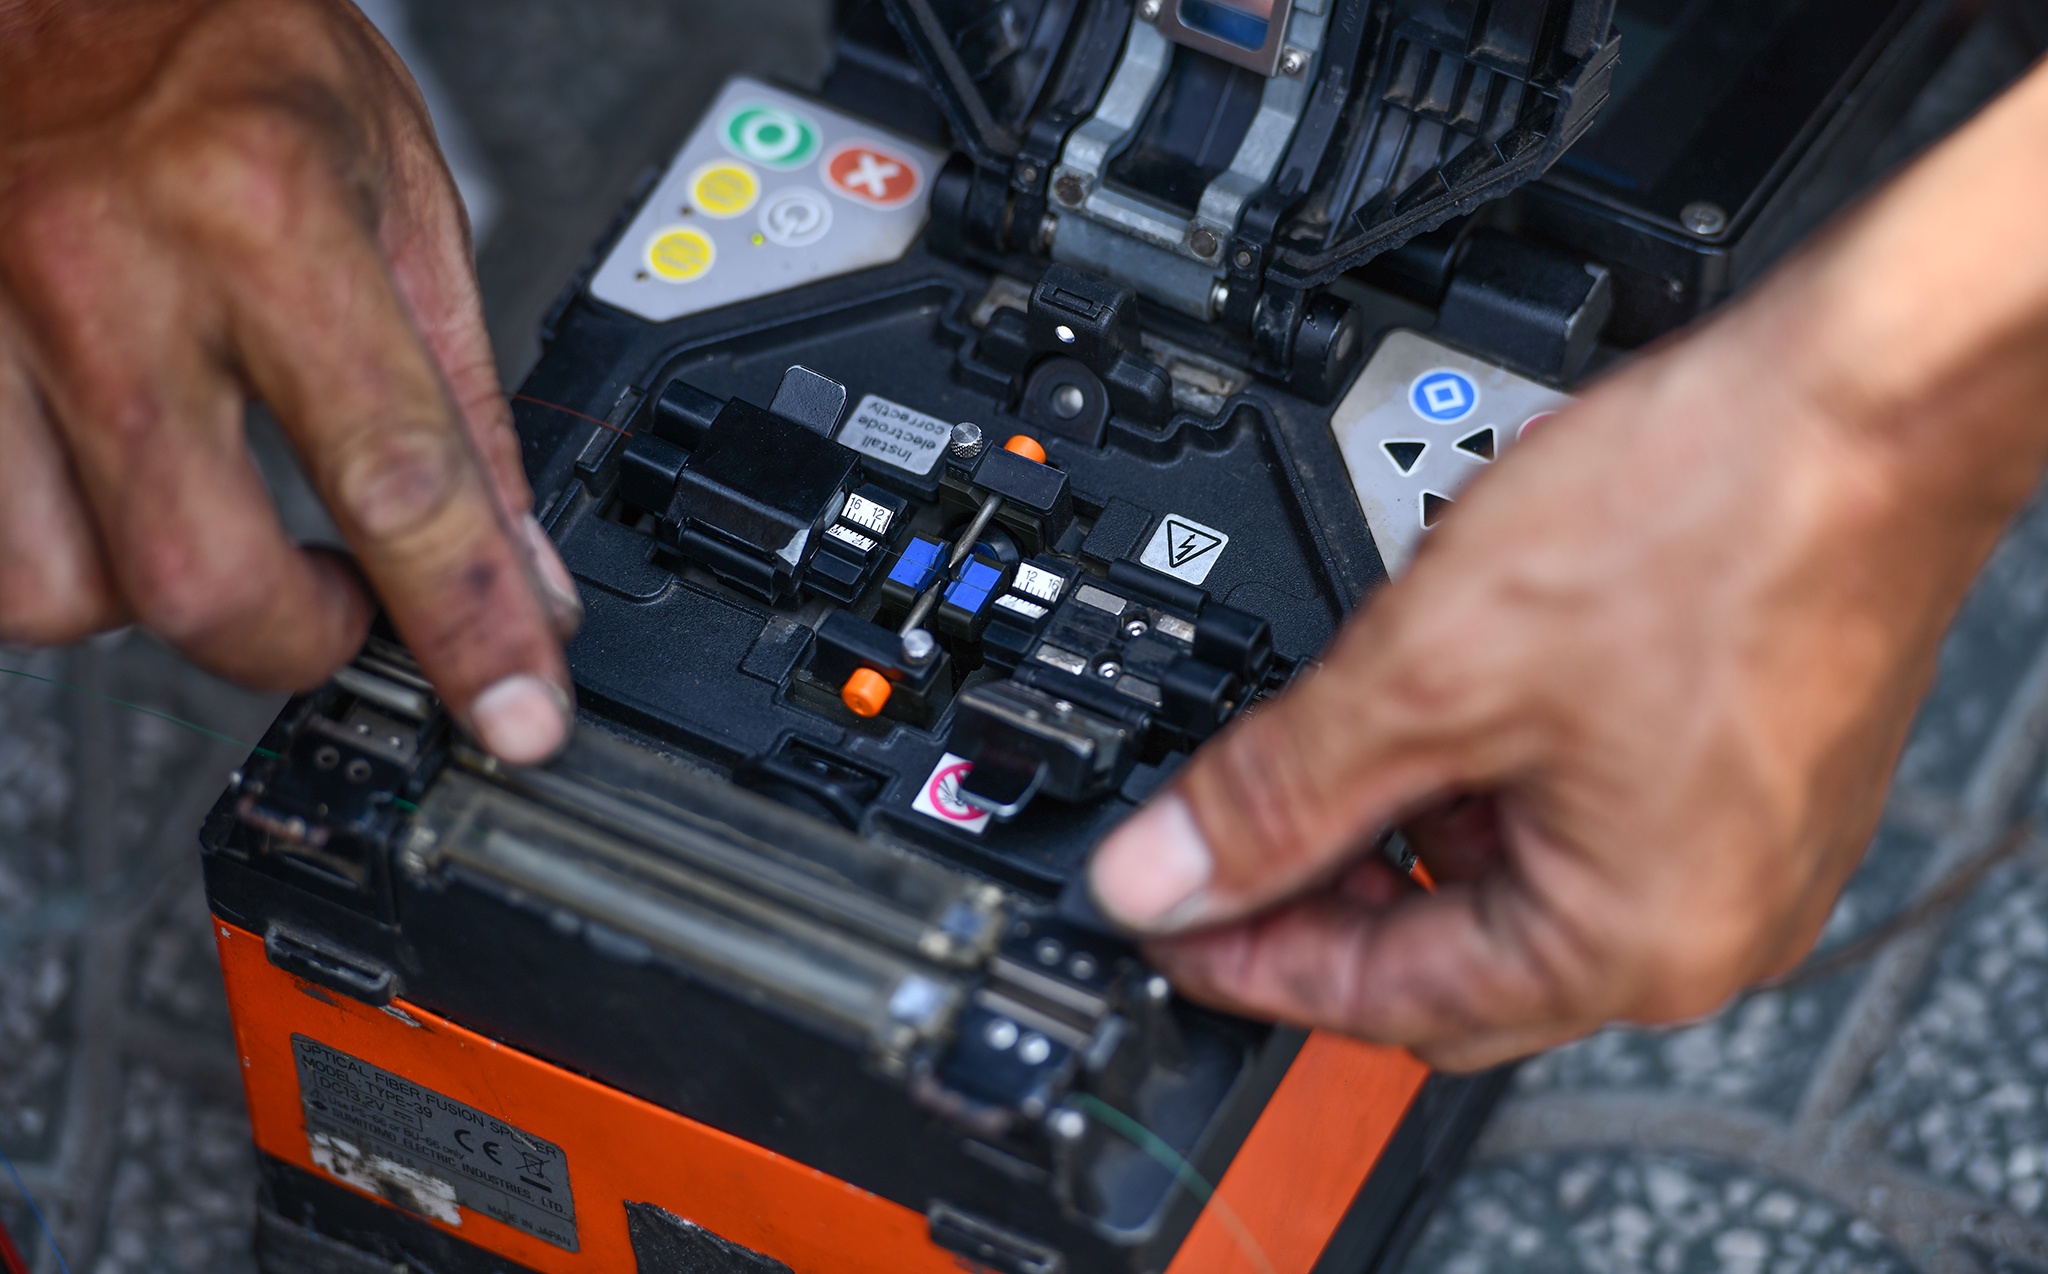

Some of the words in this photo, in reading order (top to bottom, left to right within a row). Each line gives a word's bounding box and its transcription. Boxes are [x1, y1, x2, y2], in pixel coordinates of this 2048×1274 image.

[858, 414, 937, 450] electrode
[867, 402, 945, 435] correctly
[861, 435, 912, 463] Install
[850, 496, 863, 510] 16
[872, 506, 885, 521] 12
[1026, 569, 1038, 583] 12
[1048, 578, 1061, 591] 16
[300, 1043, 370, 1079] OPTICAL
[374, 1072, 421, 1101] FIBER
[426, 1093, 485, 1128] FUSION
[319, 1076, 385, 1112] DC13.2V
[364, 1081, 433, 1119] TYPE-39
[331, 1107, 397, 1142] SUMITOMO
[403, 1137, 456, 1168] ELECTRIC
[541, 1196, 568, 1216] LTD.
[403, 1127, 441, 1151] BU-66
[442, 1145, 464, 1160] only
[454, 1129, 503, 1167] CE
[487, 1203, 518, 1223] MADE
[521, 1217, 533, 1231] IN
[536, 1225, 571, 1247] JAPAN
